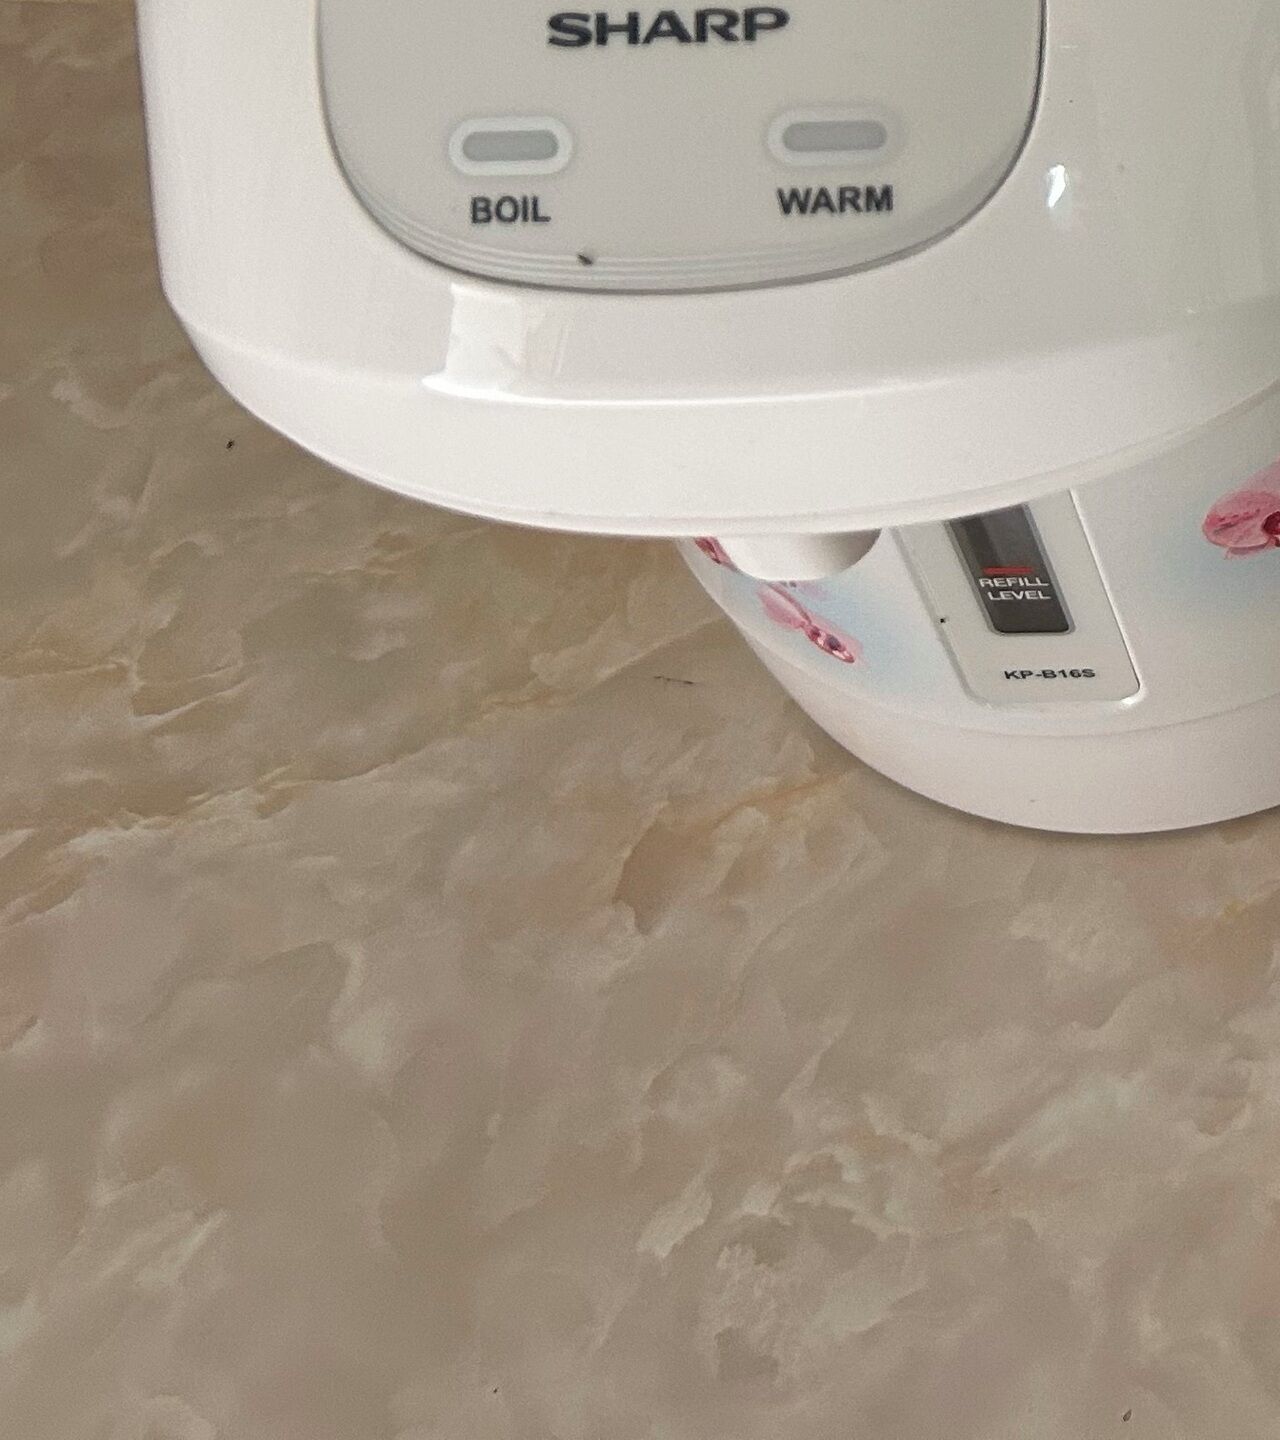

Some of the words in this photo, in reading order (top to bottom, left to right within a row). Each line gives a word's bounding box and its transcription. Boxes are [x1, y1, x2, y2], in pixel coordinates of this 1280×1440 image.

[546, 5, 791, 48] SHARP
[471, 196, 551, 225] BOIL
[777, 184, 895, 216] WARM
[979, 576, 1050, 588] REFILL
[987, 590, 1051, 601] LEVEL
[1004, 667, 1096, 681] KP-B16S
